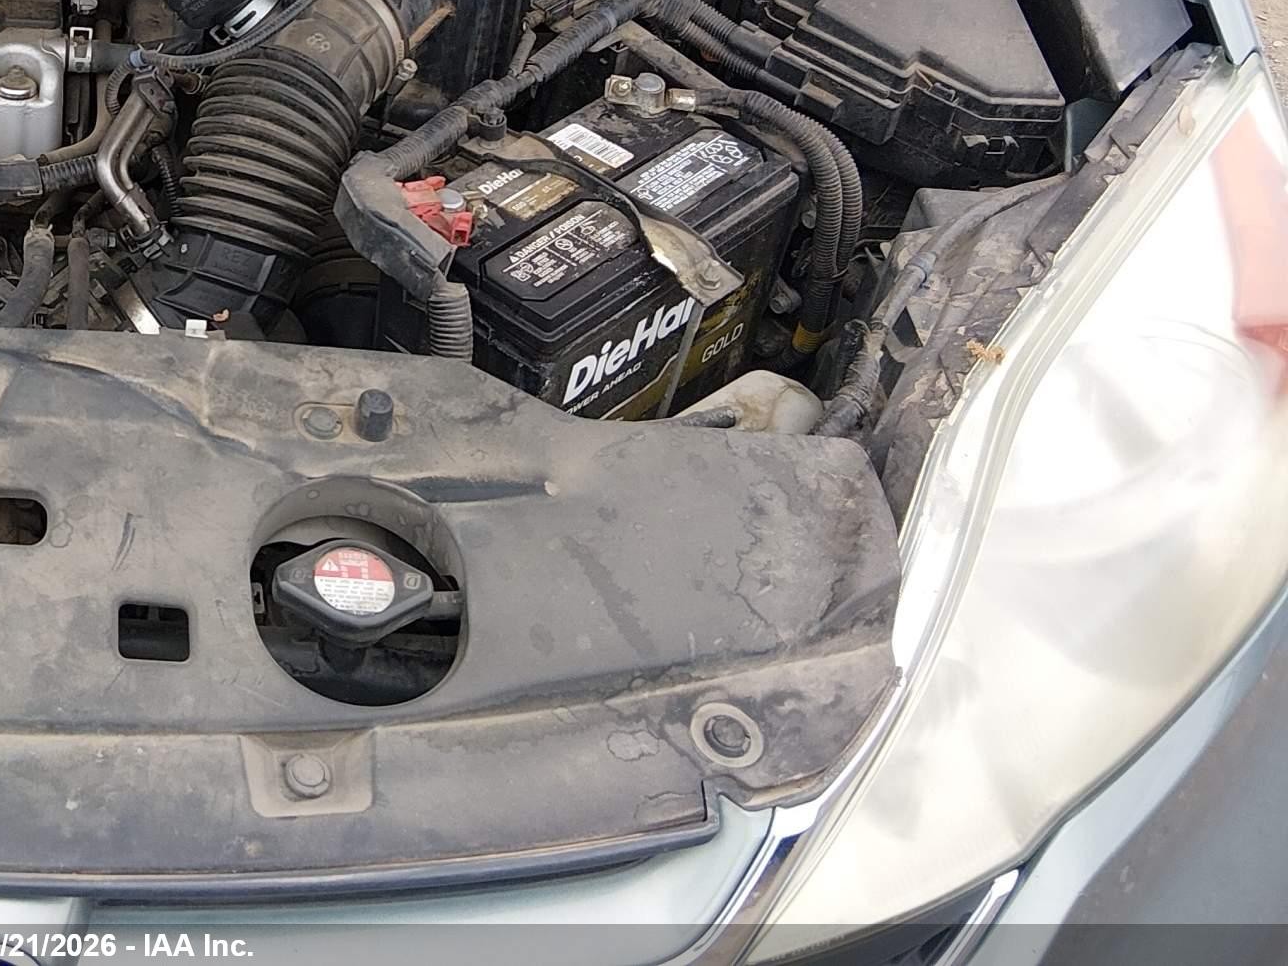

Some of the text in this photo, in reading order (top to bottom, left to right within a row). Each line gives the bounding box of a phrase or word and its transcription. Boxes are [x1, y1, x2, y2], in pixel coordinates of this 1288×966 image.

[517, 233, 551, 258] DANGER
[555, 214, 586, 235] POISON
[701, 322, 744, 363] GOLD
[601, 361, 643, 395] AHEAD
